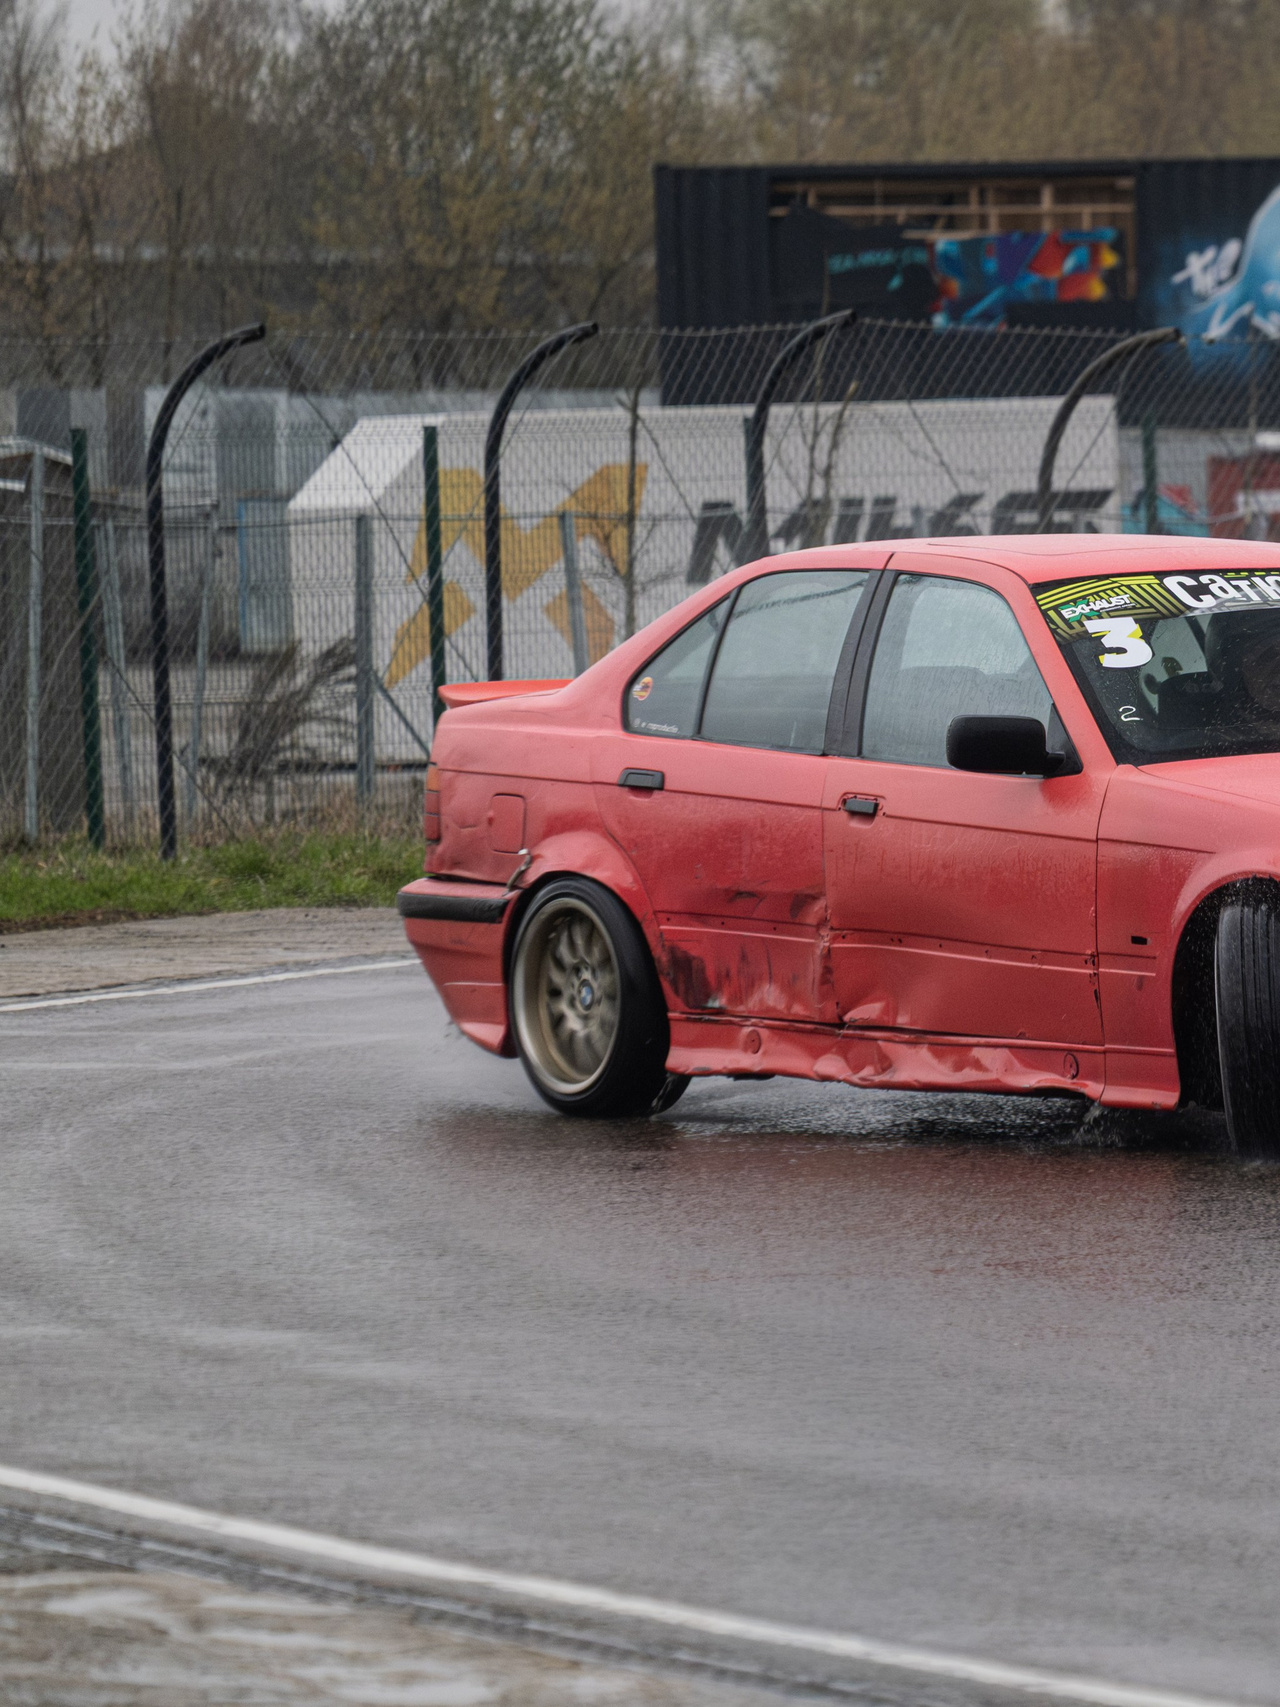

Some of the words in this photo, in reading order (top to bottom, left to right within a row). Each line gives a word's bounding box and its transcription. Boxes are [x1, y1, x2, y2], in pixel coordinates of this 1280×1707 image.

[1060, 594, 1131, 619] EXHAUST
[1083, 616, 1153, 668] 3
[1119, 705, 1141, 721] 2
